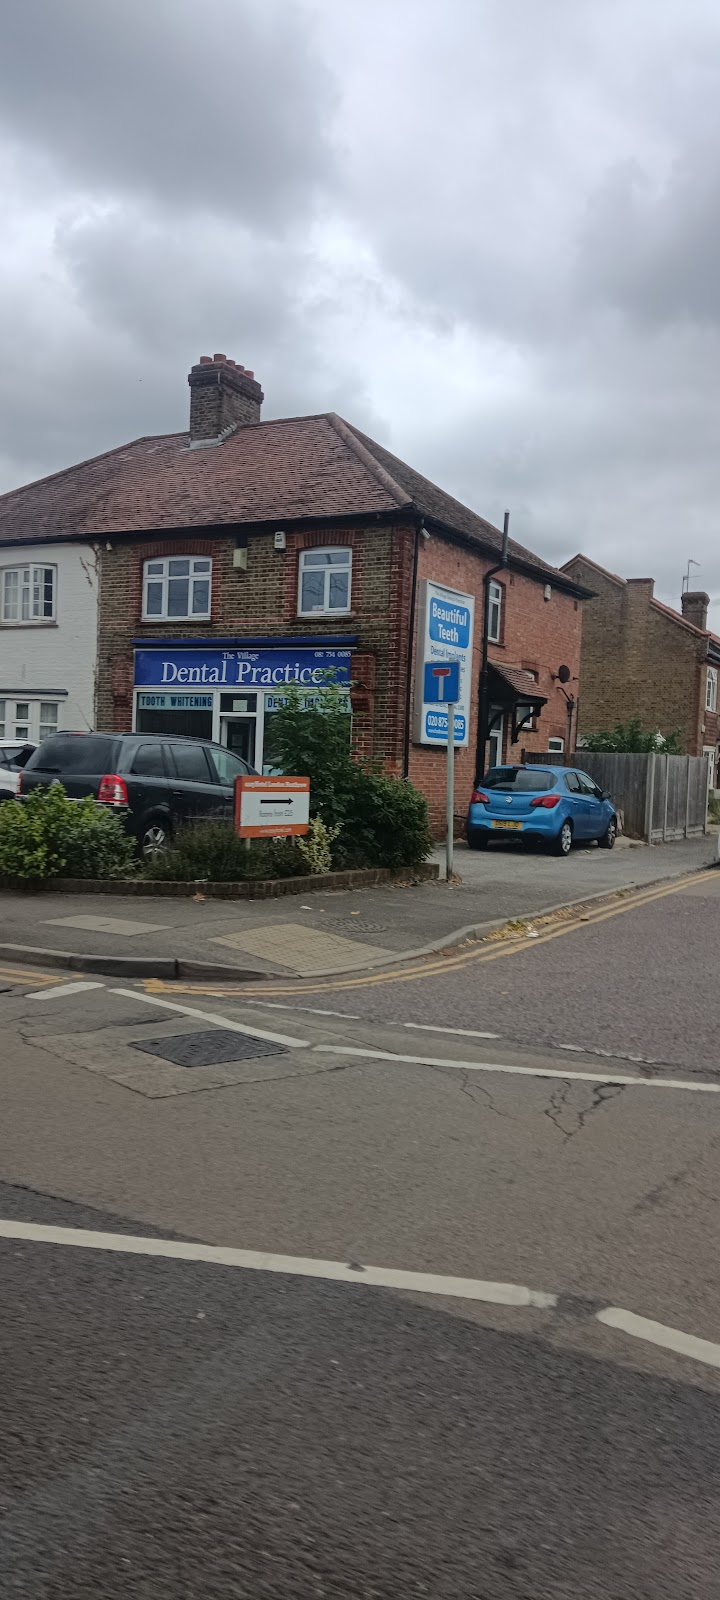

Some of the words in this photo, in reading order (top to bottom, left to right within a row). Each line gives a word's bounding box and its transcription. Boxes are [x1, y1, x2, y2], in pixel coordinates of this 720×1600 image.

[432, 602, 467, 627] Beautiful
[438, 623, 459, 643] Teeth
[222, 652, 235, 660] The
[237, 651, 260, 661] Village
[431, 645, 445, 658] Dental
[160, 660, 228, 683] Dental
[236, 661, 324, 684] Practice
[141, 696, 166, 706] TOOTH
[170, 696, 213, 707] WHITENING
[428, 715, 438, 727] 020
